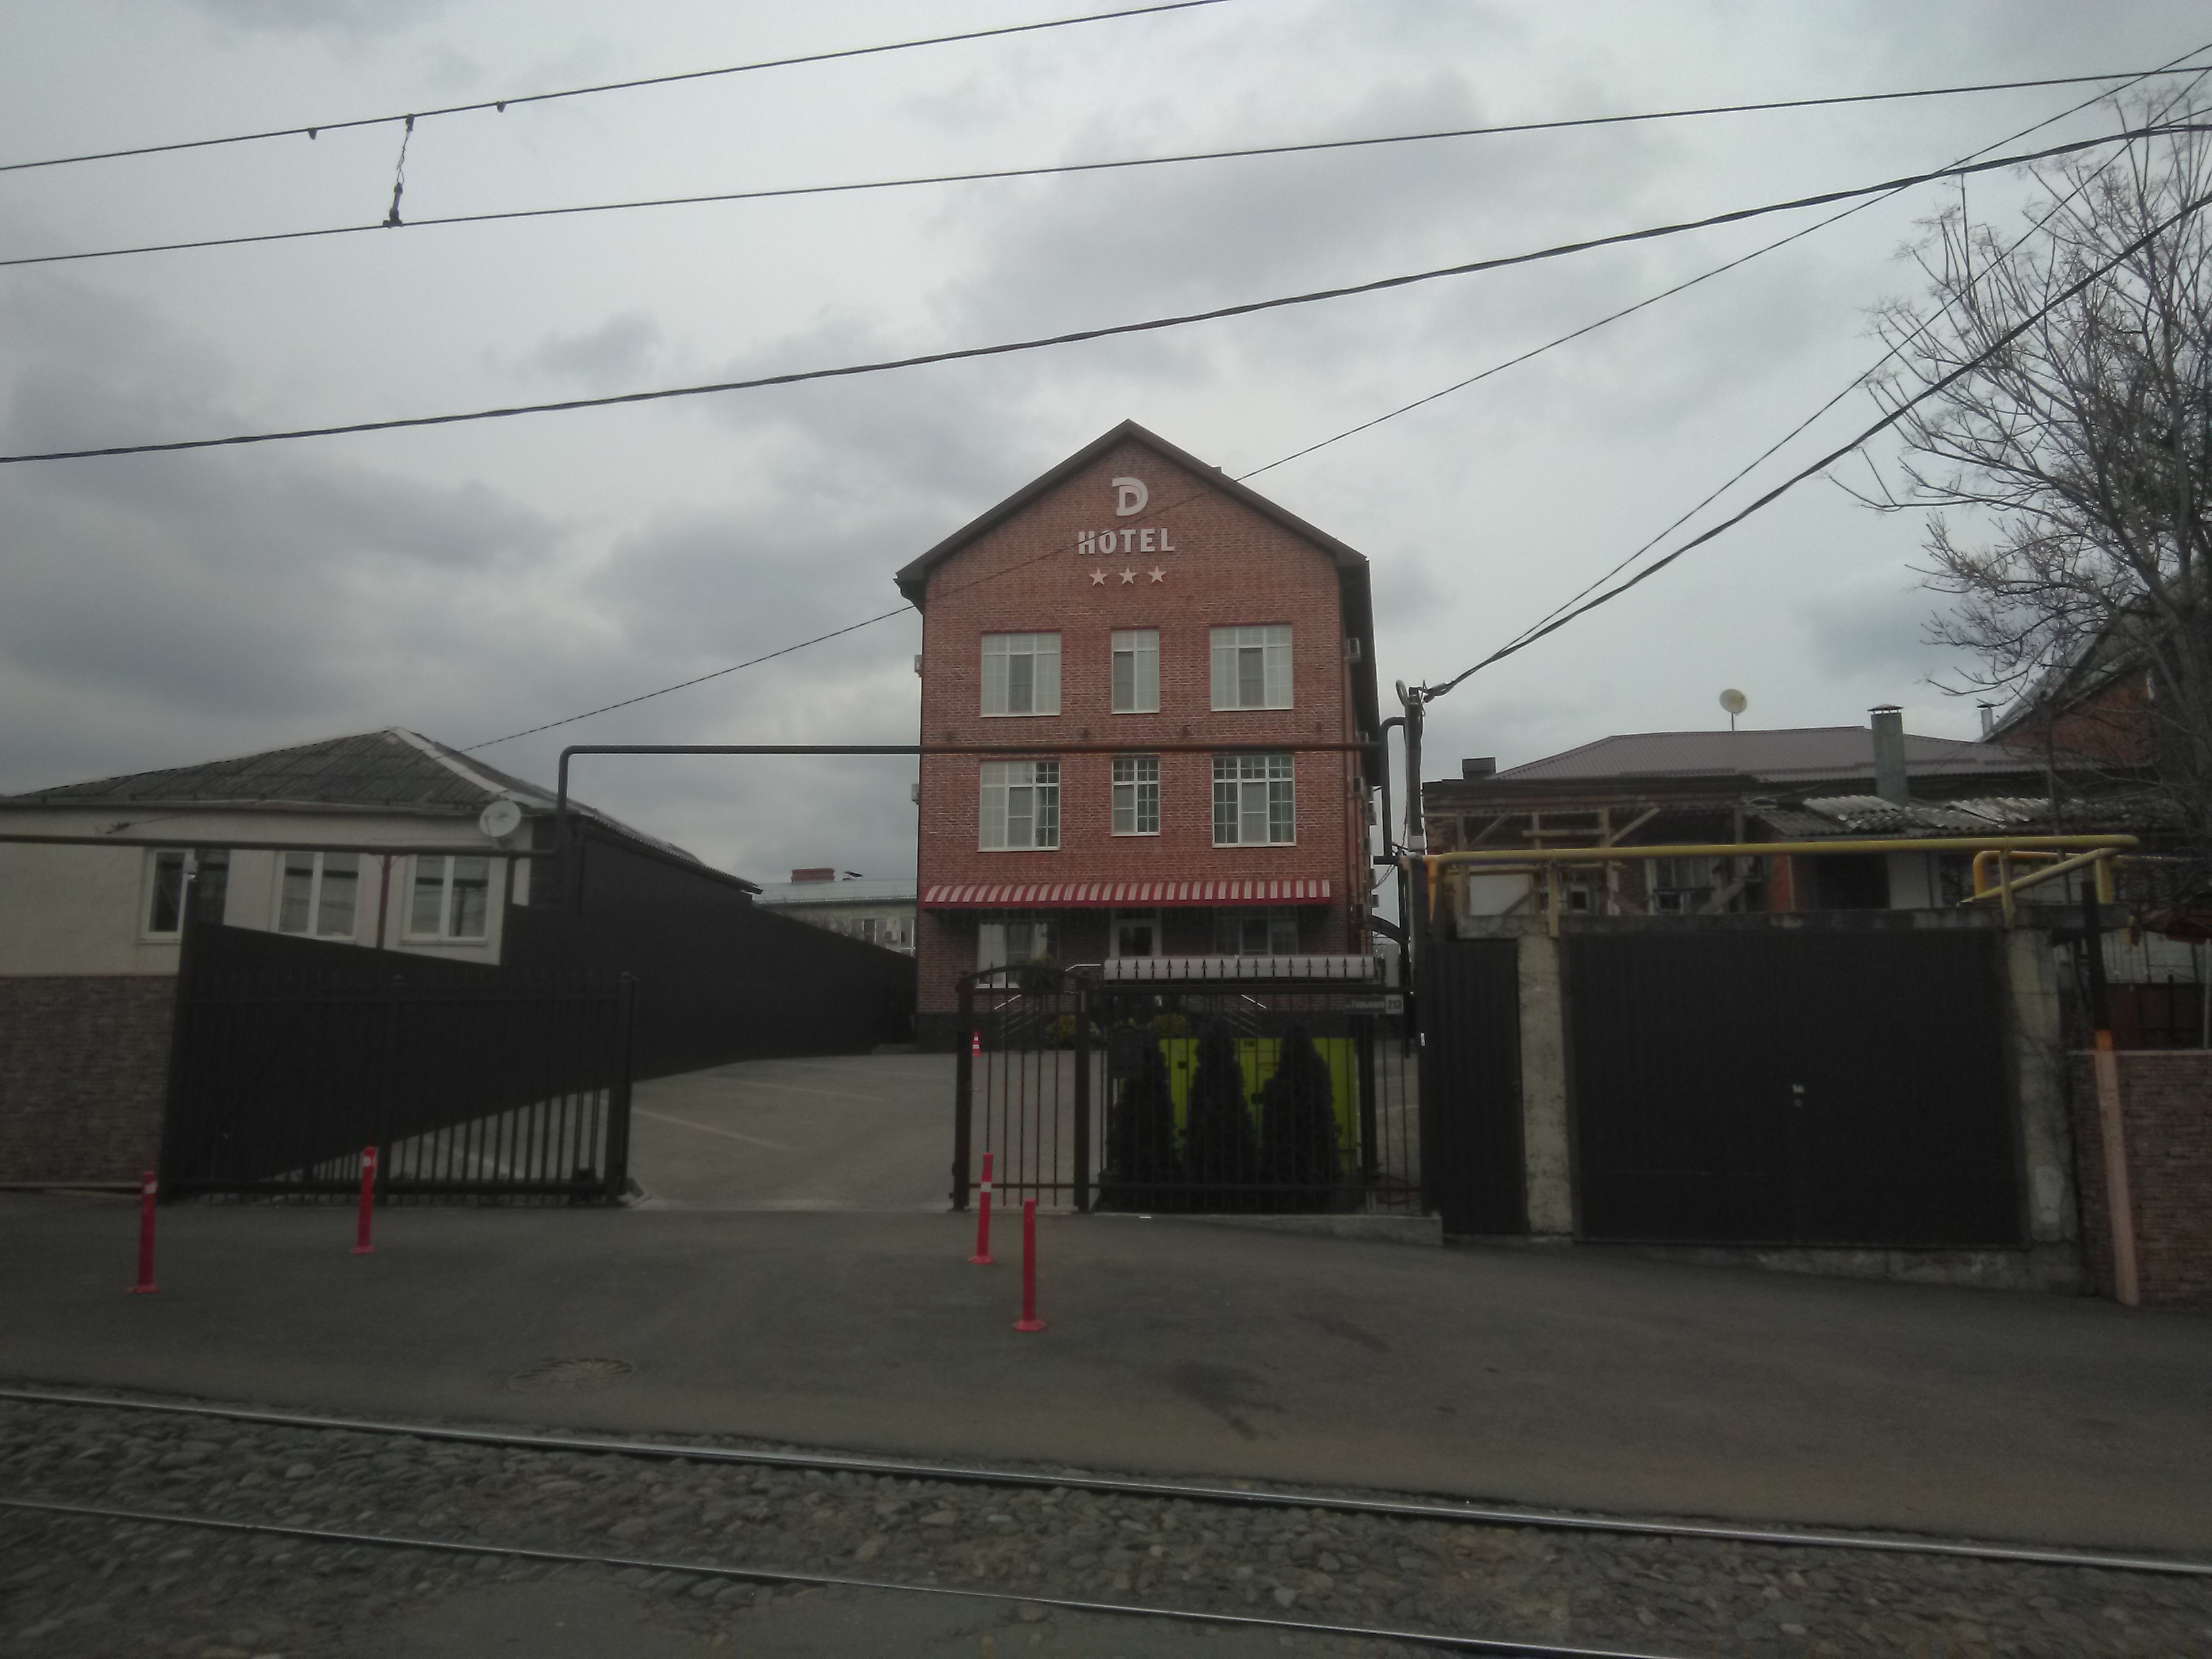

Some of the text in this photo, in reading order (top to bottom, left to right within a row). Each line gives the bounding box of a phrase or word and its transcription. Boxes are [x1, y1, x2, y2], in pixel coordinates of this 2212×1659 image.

[1111, 476, 1149, 517] D
[1078, 527, 1175, 555] HOTEL
[1387, 999, 1403, 1009] 213
